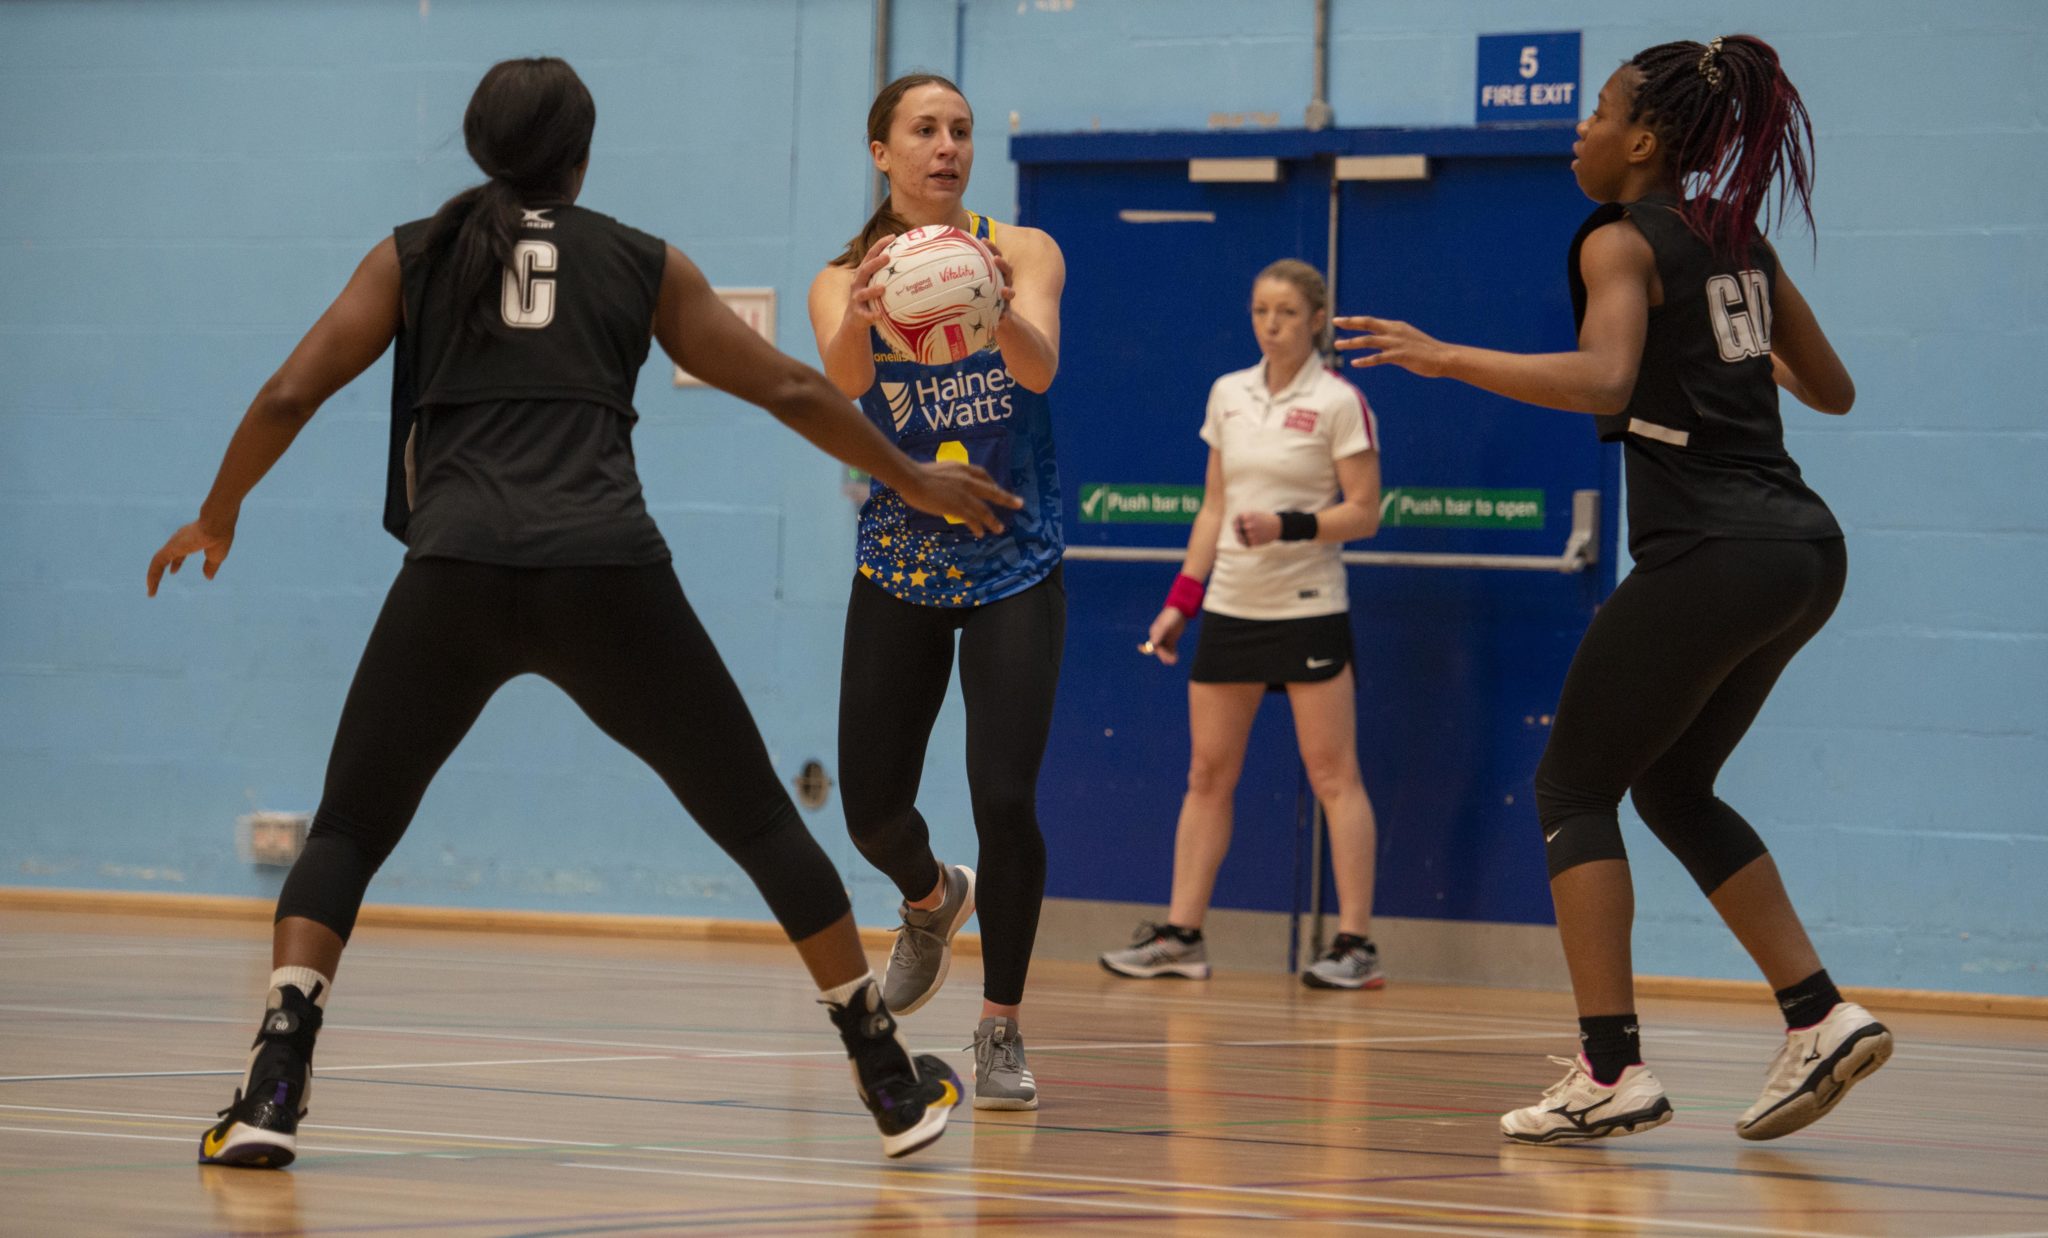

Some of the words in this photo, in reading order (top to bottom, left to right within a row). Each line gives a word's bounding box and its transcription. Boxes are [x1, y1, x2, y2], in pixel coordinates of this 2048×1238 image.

[1519, 46, 1539, 79] 5
[1481, 84, 1527, 107] FIRE
[1529, 82, 1575, 106] EXIT
[502, 240, 557, 328] C
[906, 277, 931, 292] England
[939, 264, 975, 283] Vitality
[1705, 269, 1773, 363] GD
[916, 368, 1016, 405] Haines
[921, 394, 1013, 432] Watts
[1107, 492, 1150, 513] Push
[1151, 493, 1180, 513] bar
[1181, 494, 1201, 514] to
[1400, 496, 1442, 515] Push
[1444, 497, 1474, 516] bar
[1475, 498, 1493, 517] to
[1495, 500, 1538, 520] open
